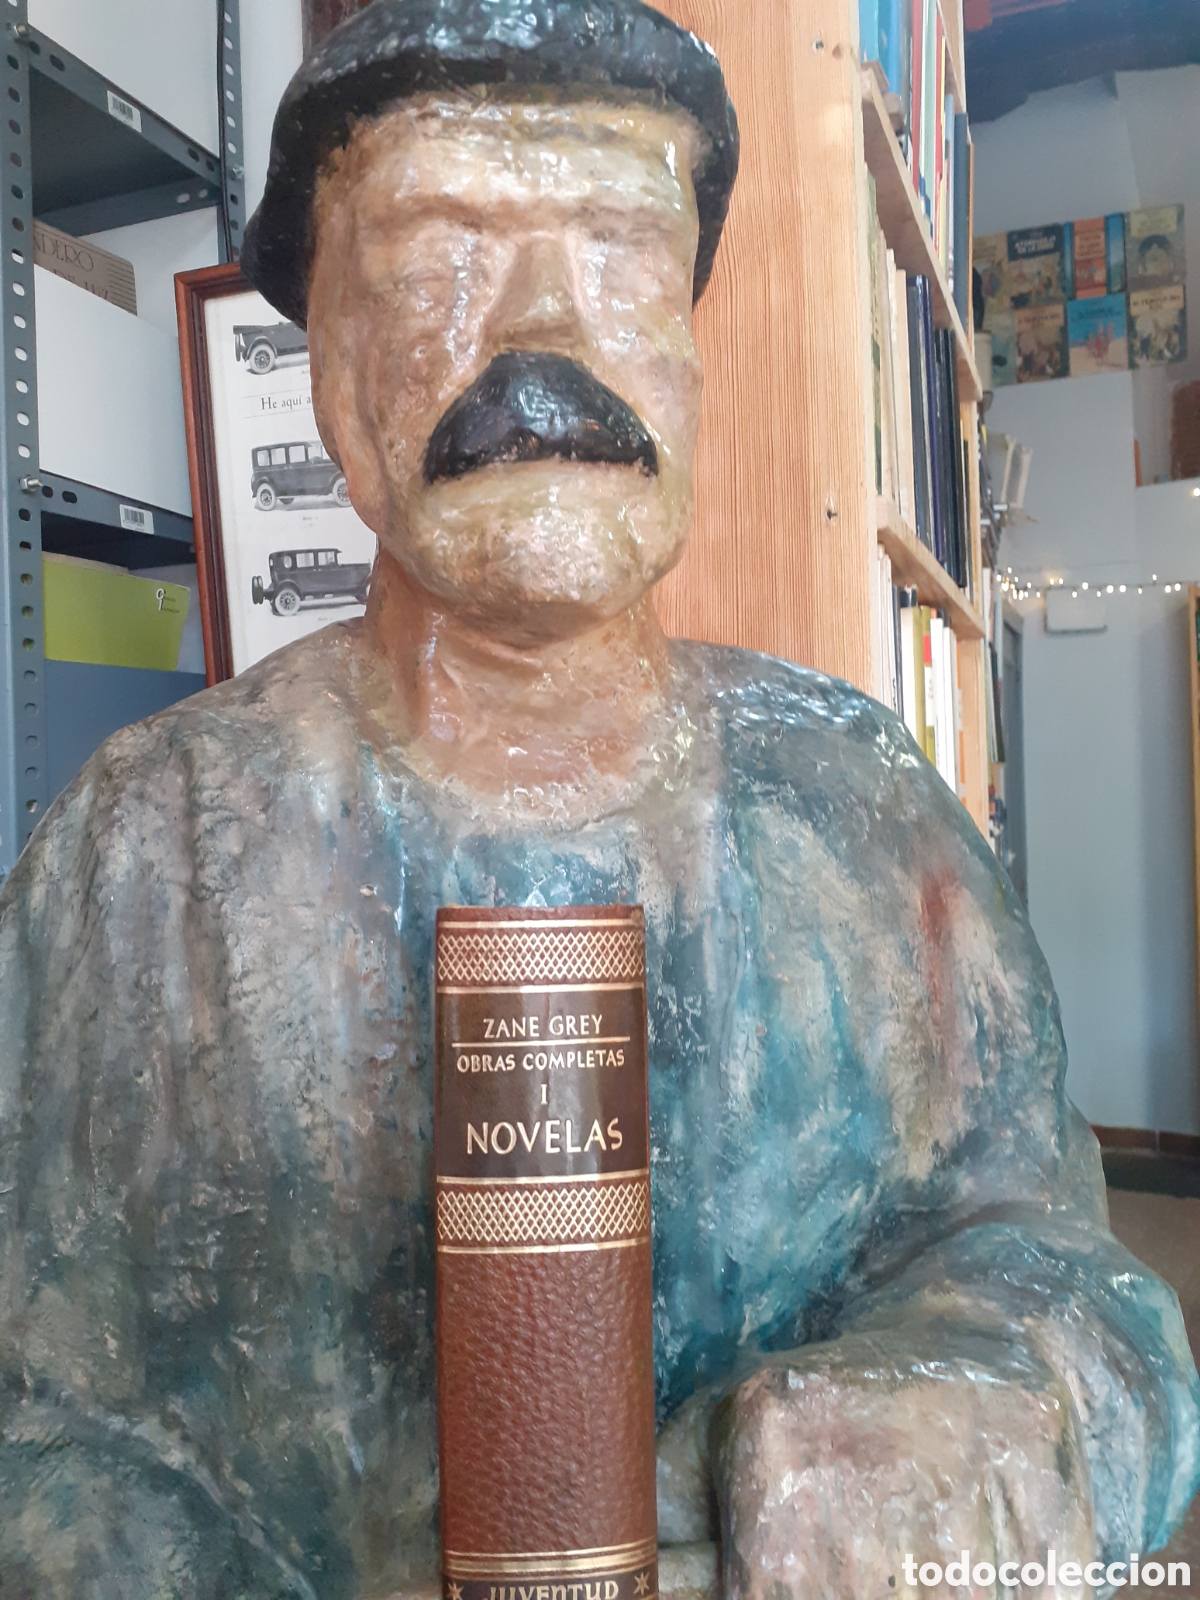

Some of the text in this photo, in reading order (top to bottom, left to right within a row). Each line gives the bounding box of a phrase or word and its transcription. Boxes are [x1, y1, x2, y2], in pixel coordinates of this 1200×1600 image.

[261, 397, 277, 410] He
[281, 395, 302, 410] aquí
[483, 1014, 603, 1039] ZANE GREY
[456, 1050, 625, 1073] OBRAS COMPLETAS
[540, 1083, 549, 1105] I
[466, 1117, 623, 1155] NOVELAS
[484, 1580, 620, 1600] JUVENTUD
